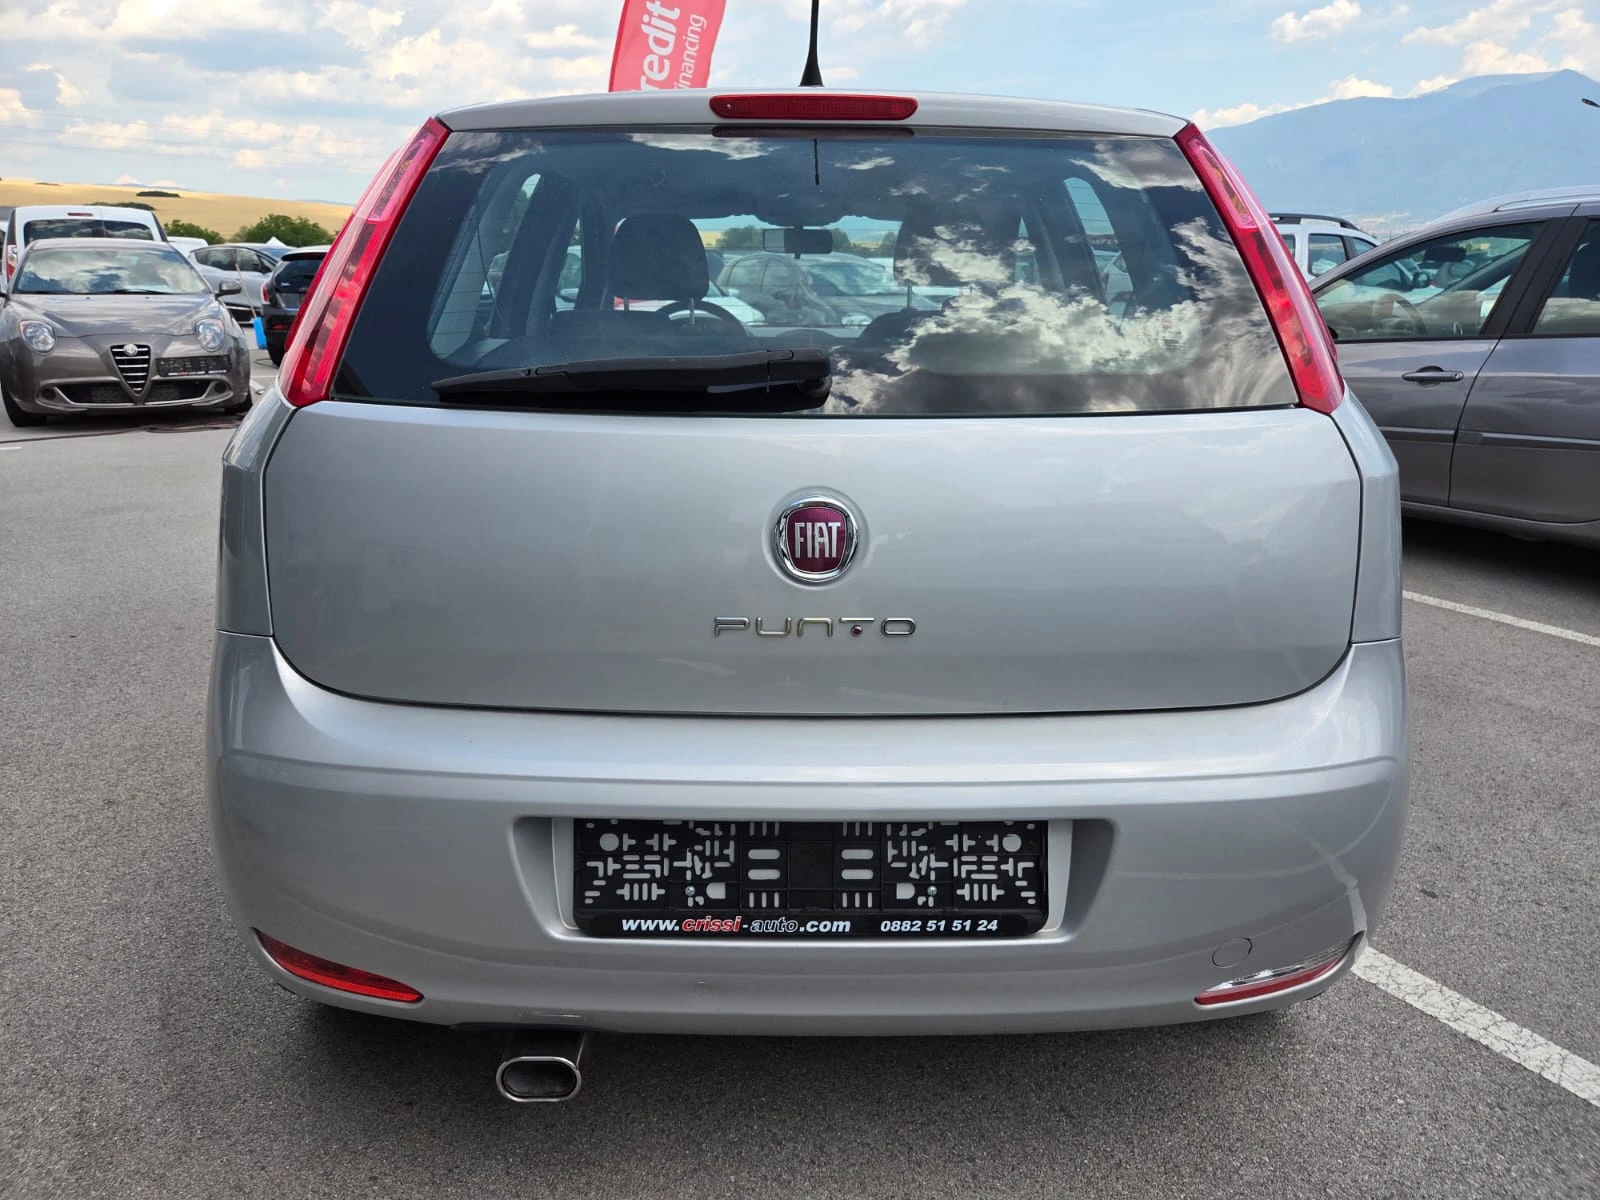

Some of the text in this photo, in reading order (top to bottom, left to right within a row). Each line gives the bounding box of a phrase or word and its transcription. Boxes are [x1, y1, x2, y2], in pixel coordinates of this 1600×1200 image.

[641, 0, 680, 91] redit
[673, 14, 707, 89] inancing
[794, 522, 841, 559] FIAT
[714, 616, 917, 637] PUNTO
[622, 915, 998, 933] www.crissi-auto.com 0882 51 51 24
